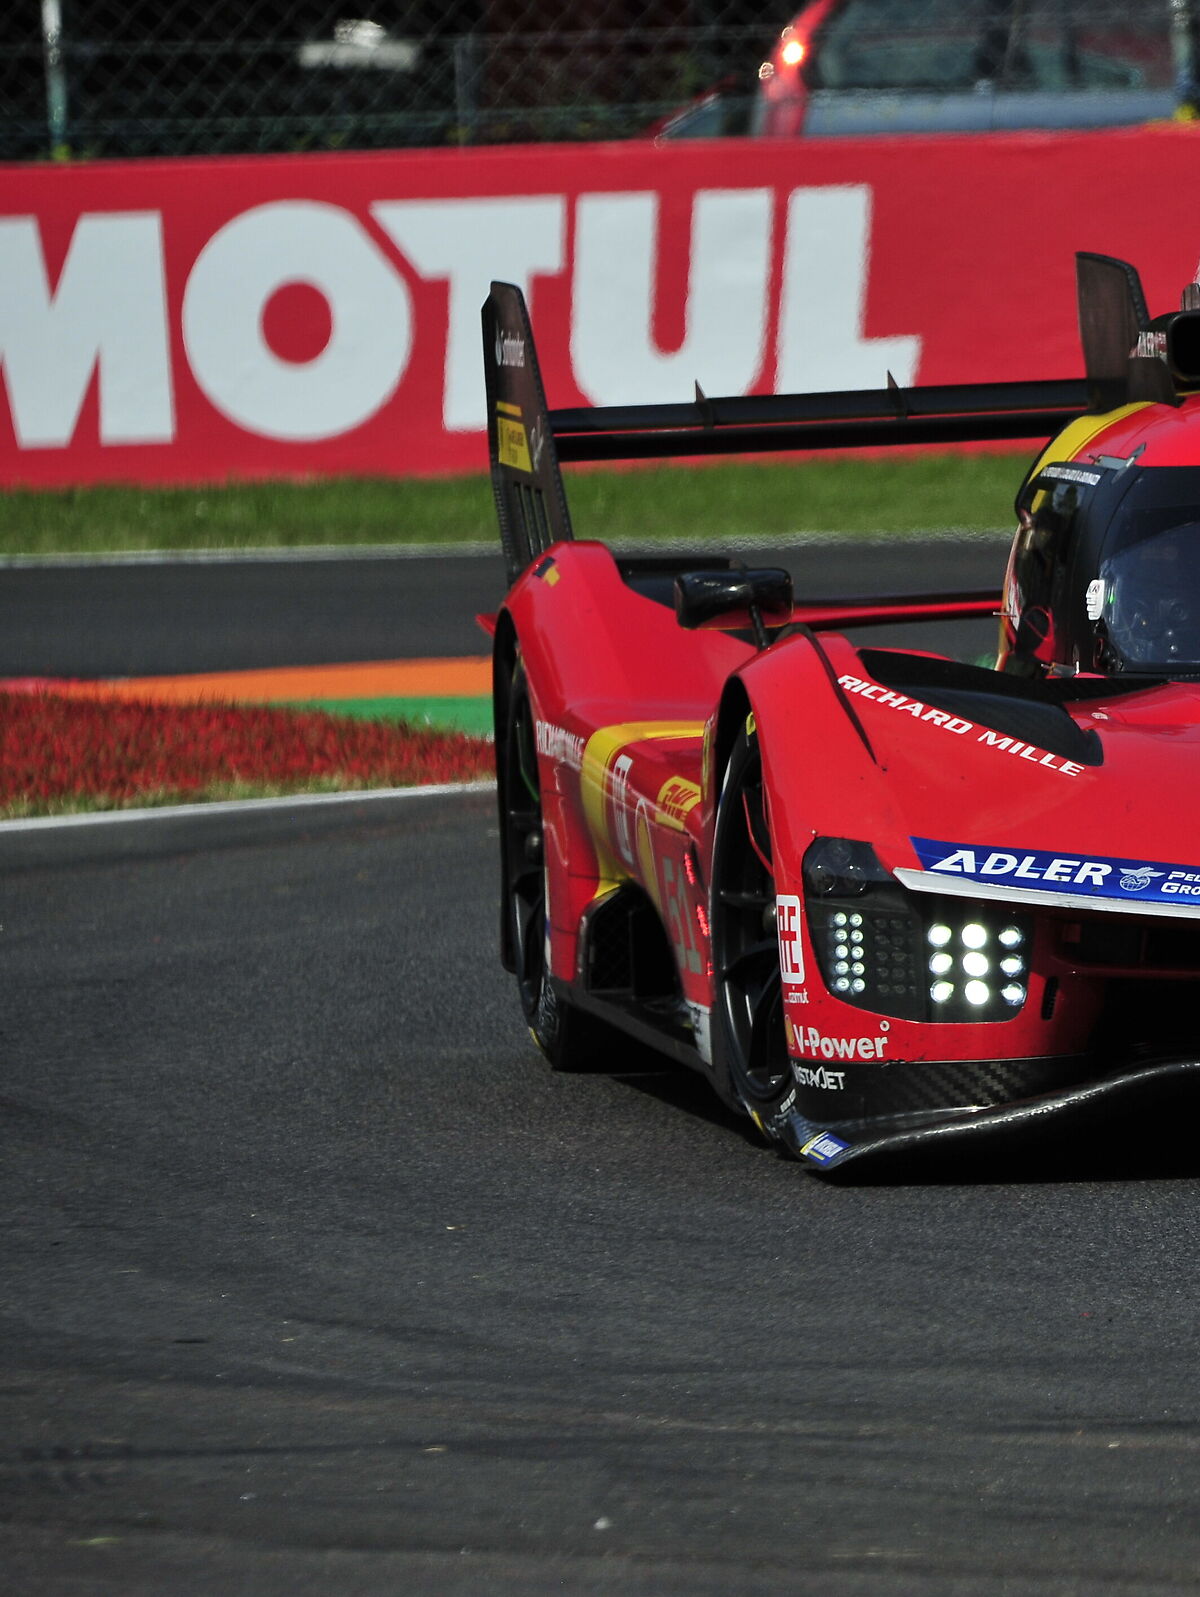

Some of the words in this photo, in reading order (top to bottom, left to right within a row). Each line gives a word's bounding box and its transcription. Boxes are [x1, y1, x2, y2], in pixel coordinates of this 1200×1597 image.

[0, 182, 924, 450] MOTUL
[837, 674, 974, 735] RICHARD
[977, 730, 1085, 777] MILLE
[929, 849, 1113, 886] ADLER
[793, 1023, 889, 1059] V-Power
